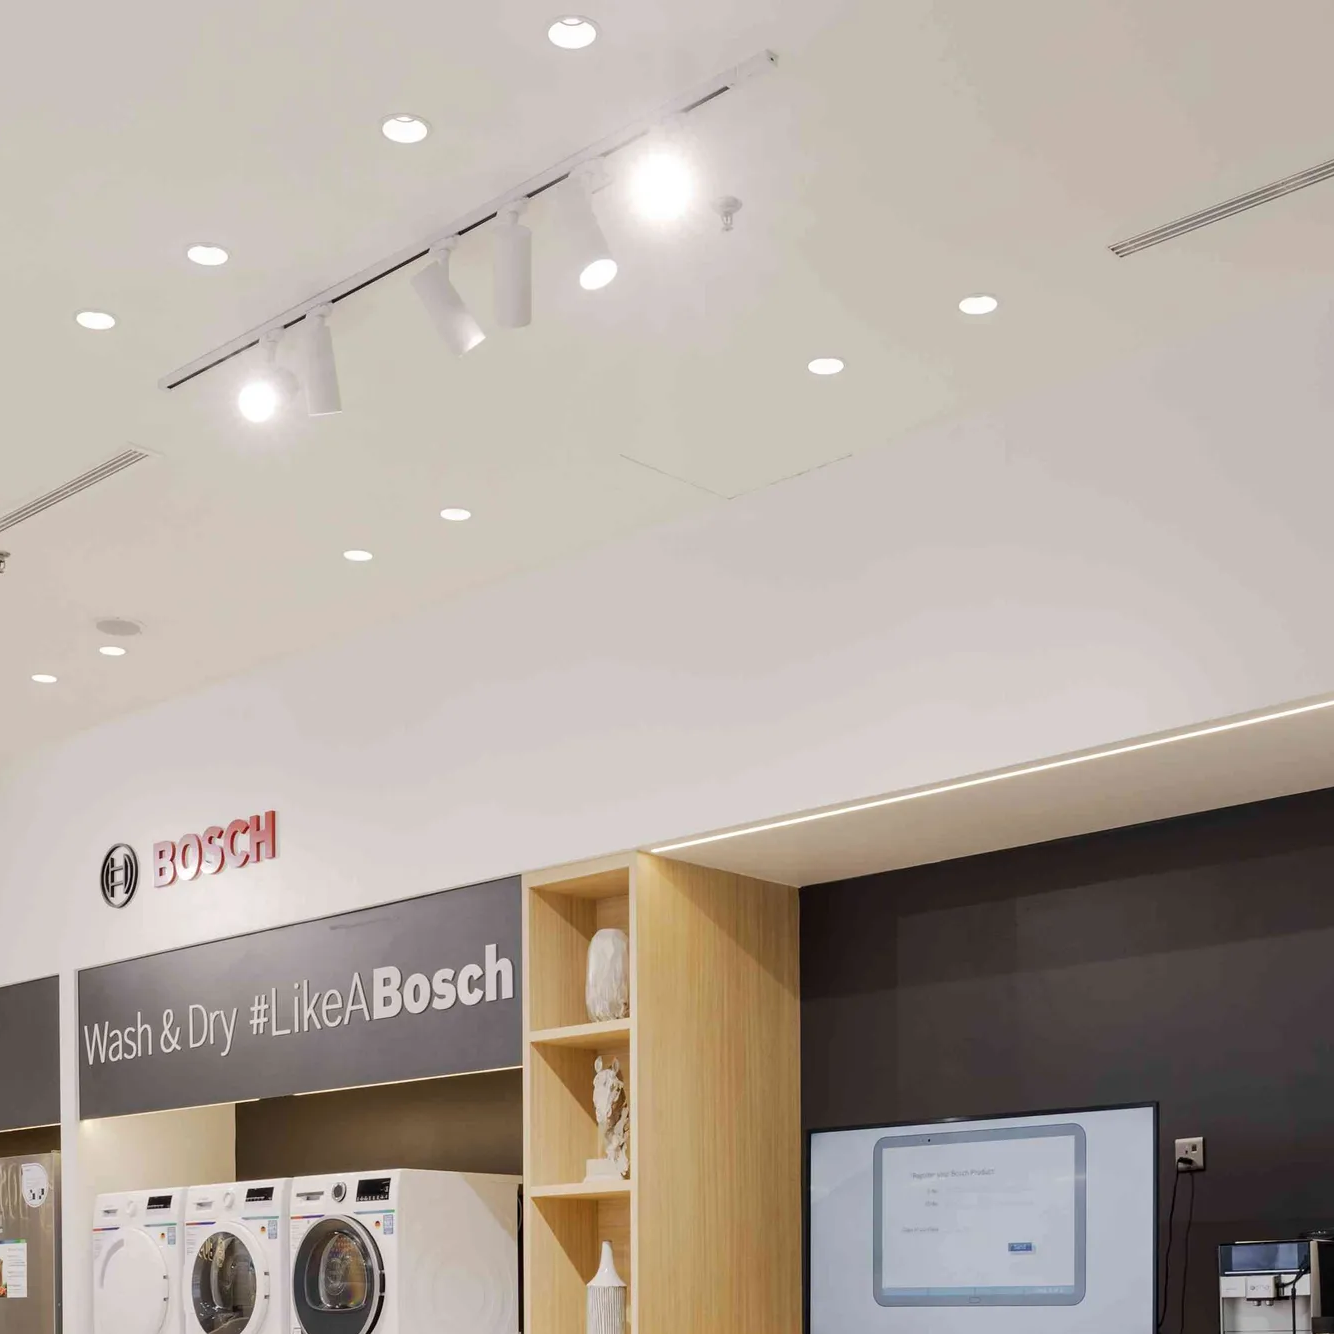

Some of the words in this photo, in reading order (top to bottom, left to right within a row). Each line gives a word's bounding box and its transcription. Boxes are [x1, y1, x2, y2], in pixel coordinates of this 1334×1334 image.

[153, 810, 276, 888] BOSCH
[84, 1011, 152, 1066] Wash
[159, 1008, 182, 1054] &
[189, 1003, 238, 1056] Dry
[249, 943, 514, 1036] #LikeABosch
